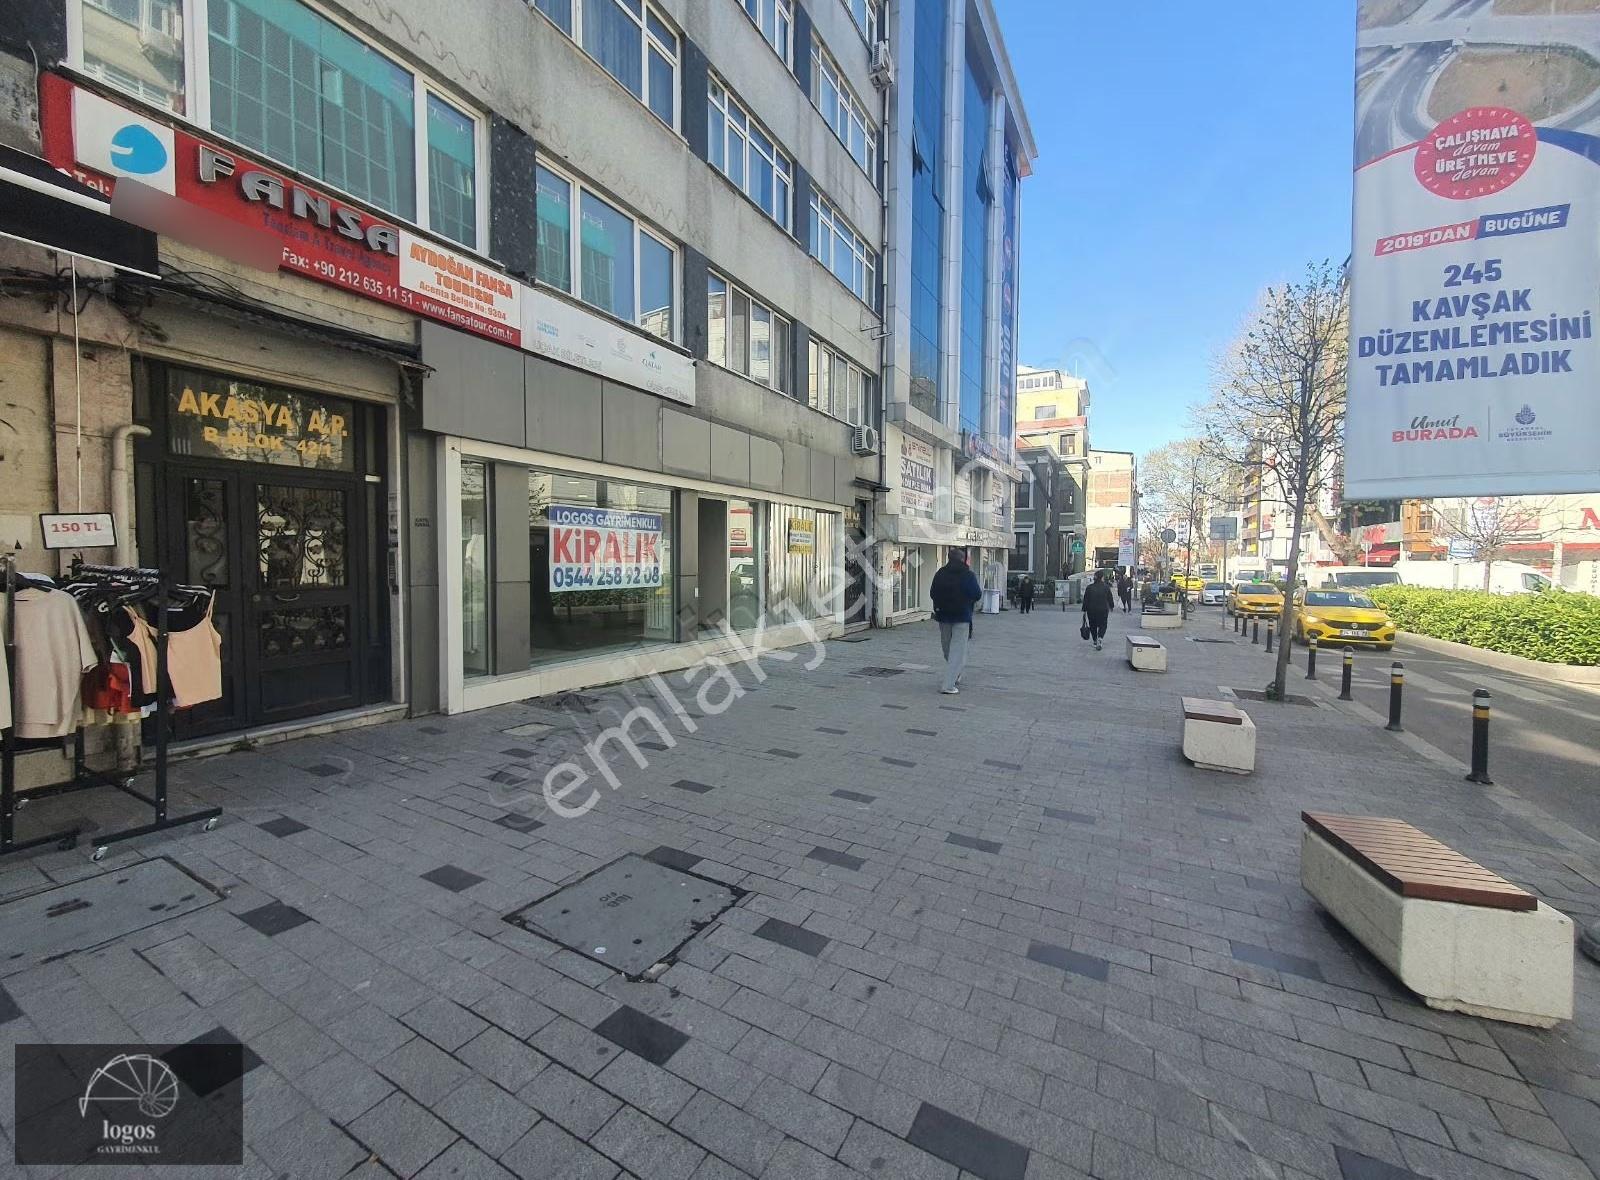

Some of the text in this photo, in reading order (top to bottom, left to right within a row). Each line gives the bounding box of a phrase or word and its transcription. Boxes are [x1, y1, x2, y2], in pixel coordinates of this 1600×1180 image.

[1435, 124, 1519, 150] ÇALIŞMAYA
[1435, 150, 1517, 173] ÜRETMEYE
[1453, 142, 1500, 157] devam
[1452, 167, 1499, 181] devam
[200, 144, 399, 257] FANSA
[1485, 211, 1560, 232] BUGÜNE
[410, 242, 513, 299] AYDOĞAN FANSA
[1444, 259, 1501, 287] 245
[282, 247, 310, 270] Fax:
[313, 260, 336, 278] +90
[339, 267, 360, 287] 212
[363, 275, 384, 295] 635
[386, 285, 398, 300] 11
[401, 290, 413, 305] 51
[421, 300, 513, 341] www.fansatour.com.tr
[435, 272, 494, 306] TOURISM
[451, 292, 474, 309] Belge
[1412, 289, 1531, 322] KAVŞAK
[1358, 310, 1592, 358] DÜZENLEMESİNİ
[1376, 350, 1572, 386] TAMAMLADIK
[178, 387, 294, 429] AKASYA
[1411, 415, 1460, 429] Umut
[1392, 427, 1479, 442] BURADA
[51, 523, 103, 532] 150 TL
[556, 511, 658, 529] LOGOS GAYRİMENKUL
[553, 567, 594, 587] 0544
[597, 567, 622, 585] 258
[626, 567, 641, 585] 92
